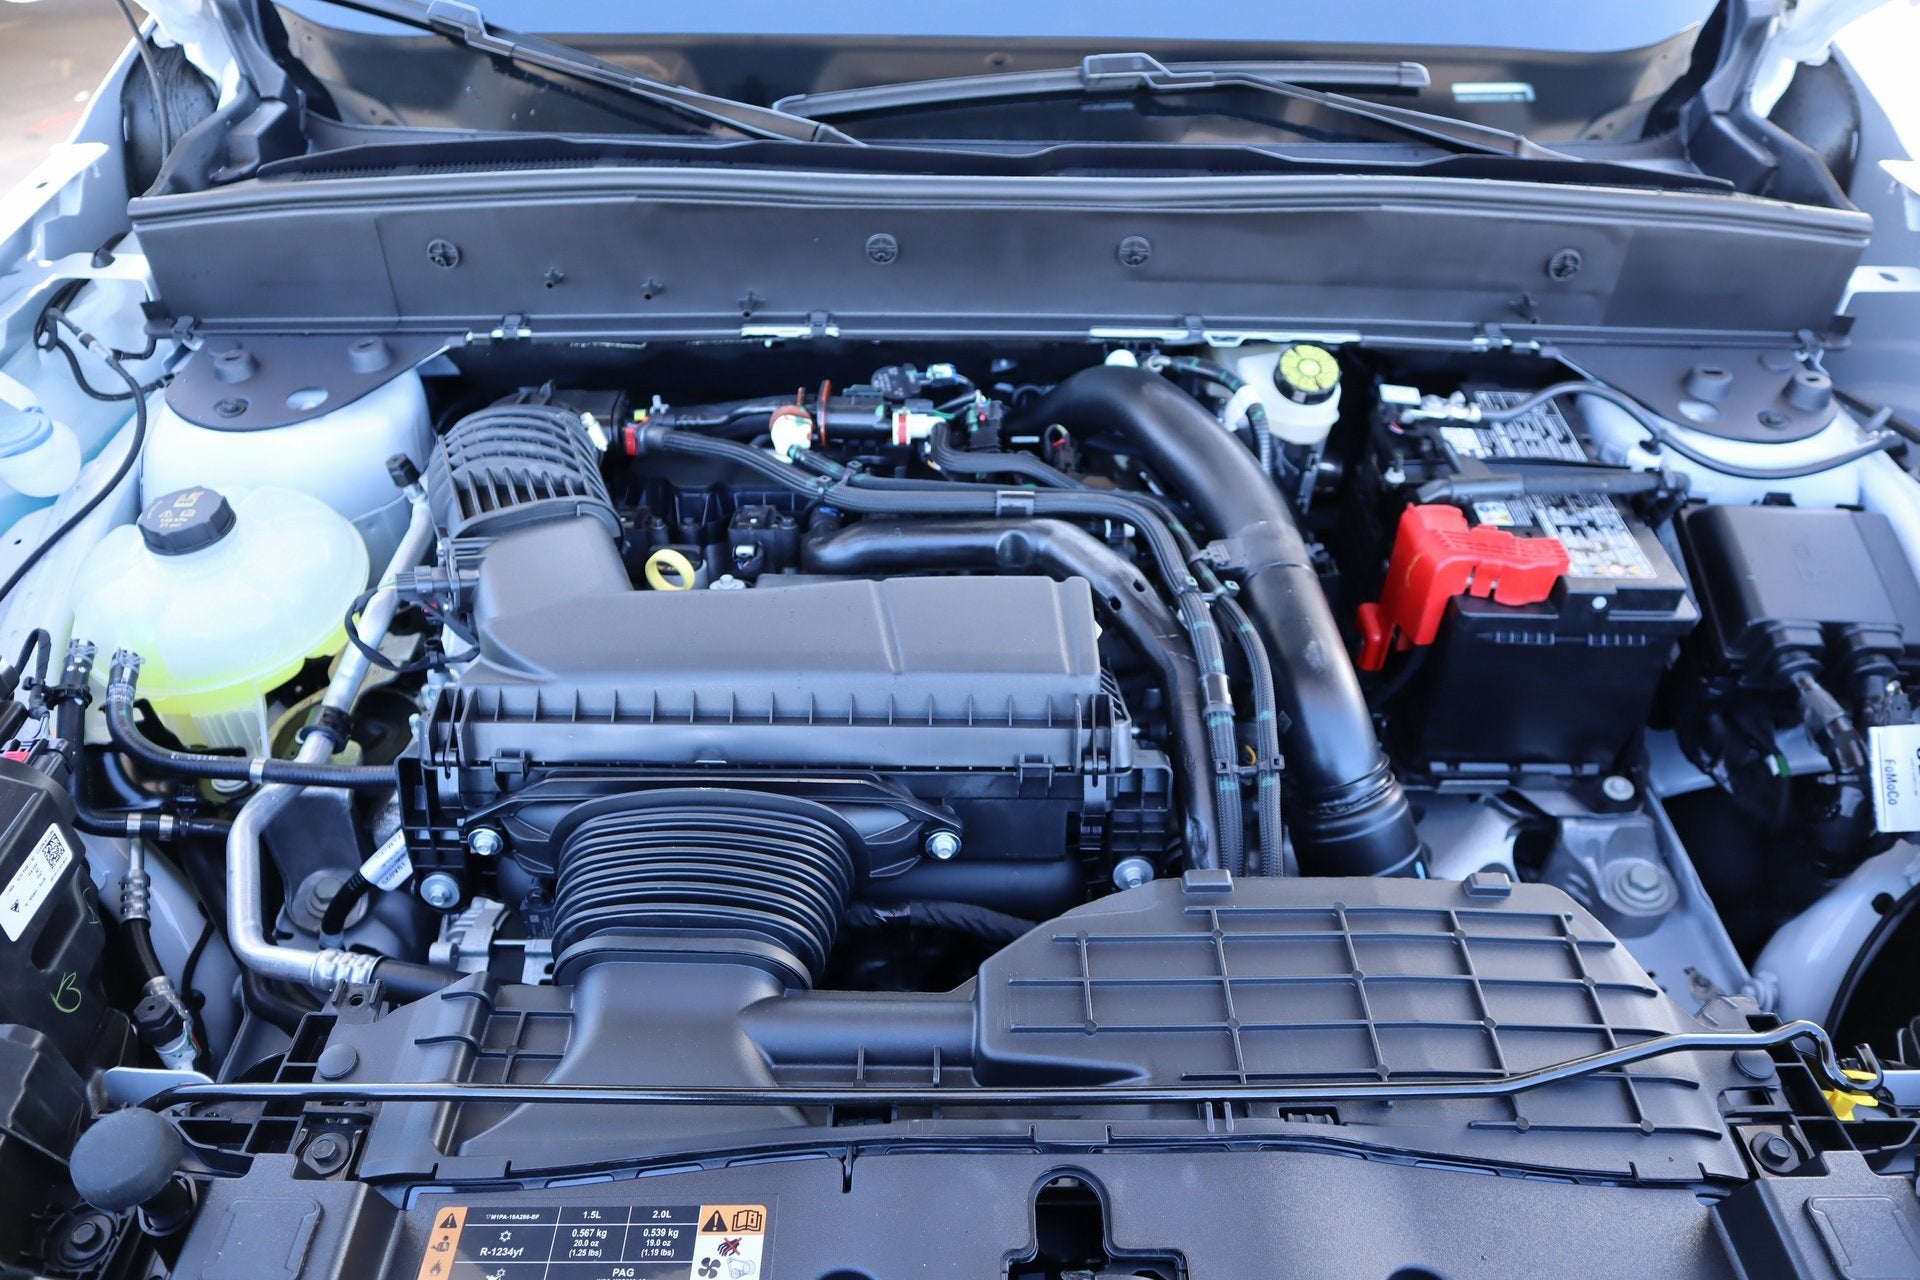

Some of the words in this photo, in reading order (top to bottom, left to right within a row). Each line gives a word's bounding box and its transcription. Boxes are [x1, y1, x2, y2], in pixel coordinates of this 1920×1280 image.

[1884, 759, 1899, 806] FoMoCo
[583, 1210, 601, 1219] 1.5L
[652, 1210, 672, 1218] 2.0L
[572, 1228, 595, 1237] 0.567
[597, 1228, 607, 1239] kg
[643, 1228, 666, 1237] 0.539
[668, 1228, 679, 1239] kg
[574, 1239, 589, 1247] 20.0
[480, 1247, 524, 1258] R-1234yf
[569, 1249, 587, 1258] (1.25
[588, 1249, 602, 1258] lbs)
[641, 1249, 659, 1258] (1.19
[660, 1249, 674, 1257] lbs)
[612, 1268, 635, 1277] PAG
